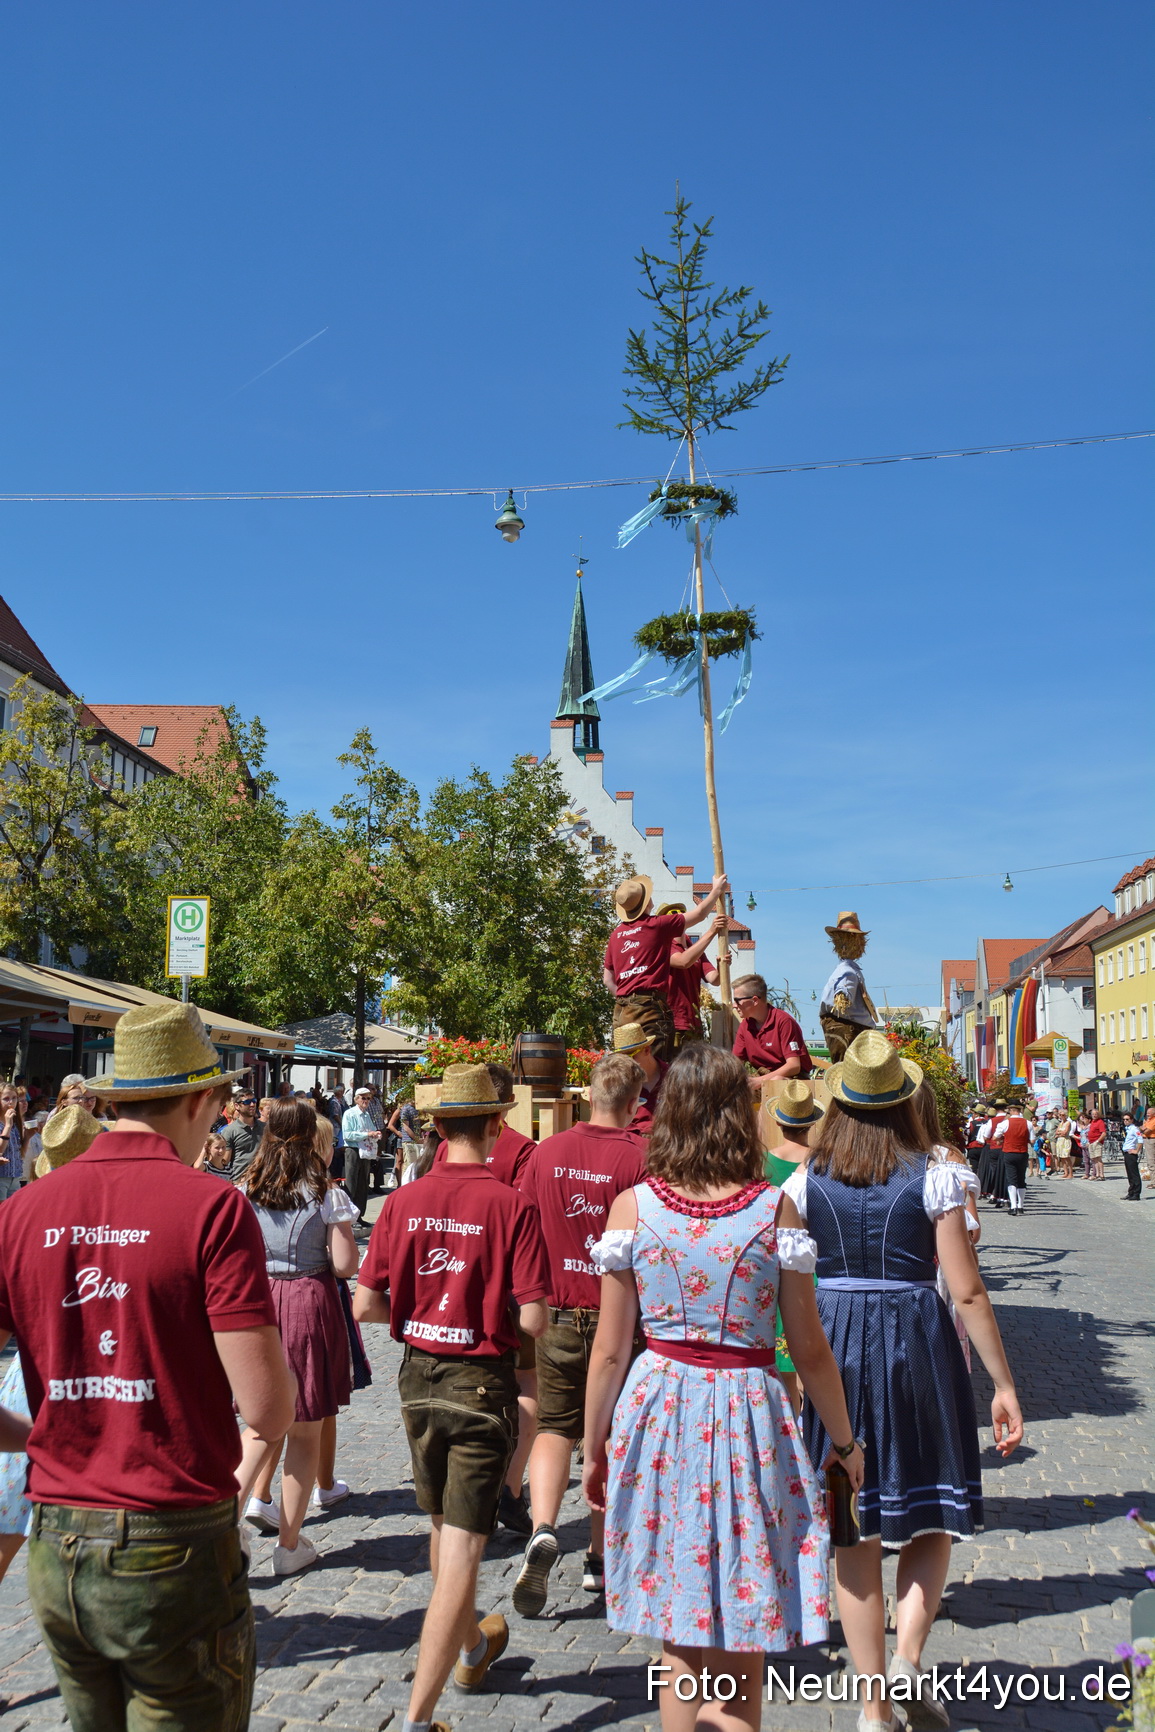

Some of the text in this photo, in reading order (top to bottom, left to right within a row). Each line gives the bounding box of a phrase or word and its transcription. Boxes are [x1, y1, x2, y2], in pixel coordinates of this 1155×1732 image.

[568, 1168, 613, 1184] Pöllinger
[43, 1226, 66, 1249] D'
[407, 1217, 484, 1237] D' Pöllinger
[584, 1233, 596, 1249] &
[402, 1319, 475, 1344] BURSCHN
[98, 1329, 119, 1356] &
